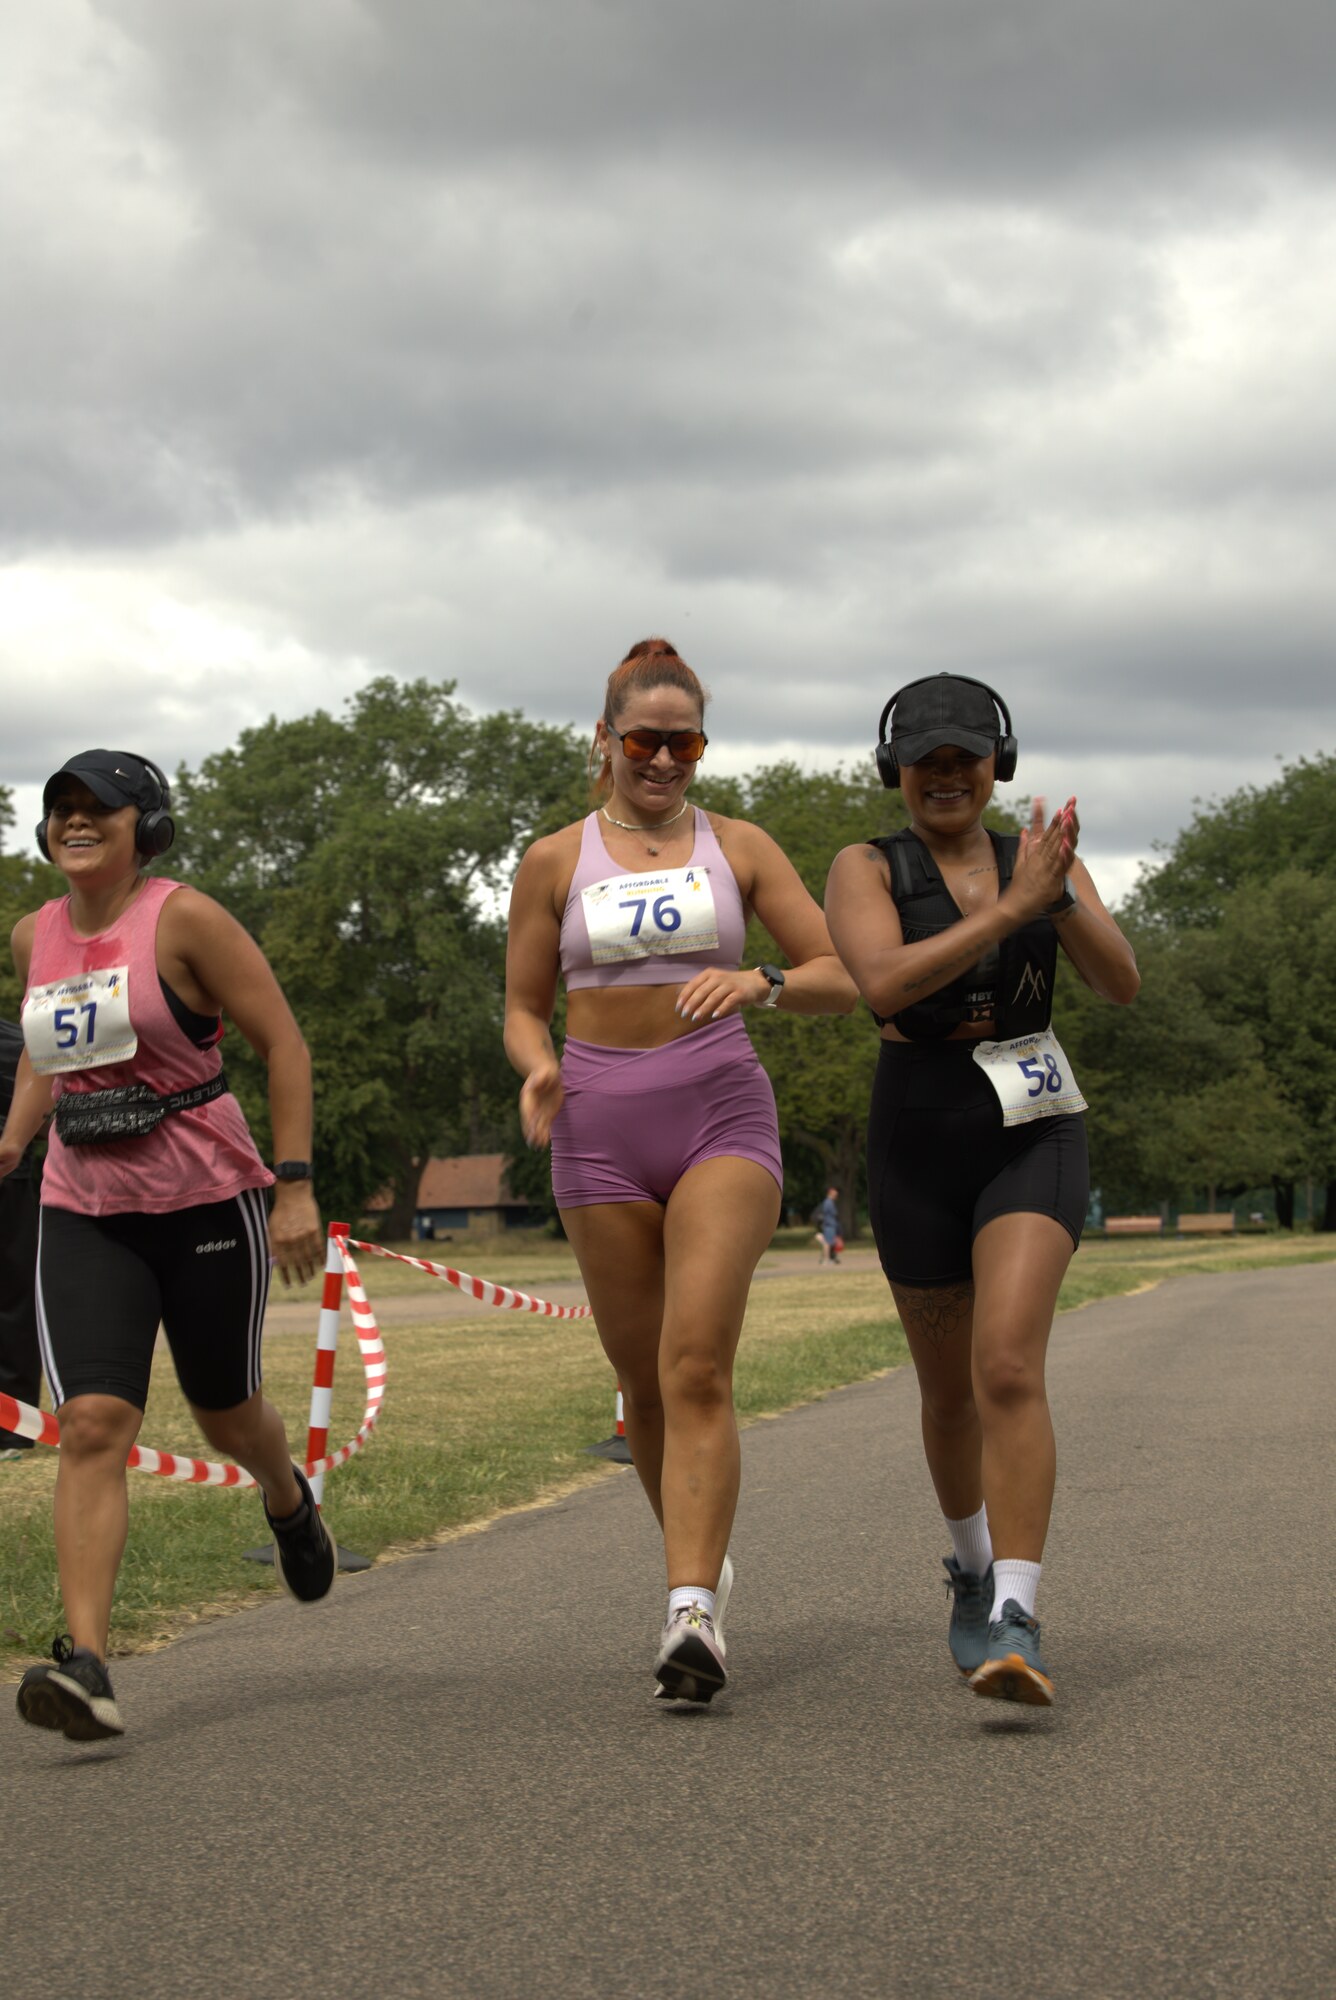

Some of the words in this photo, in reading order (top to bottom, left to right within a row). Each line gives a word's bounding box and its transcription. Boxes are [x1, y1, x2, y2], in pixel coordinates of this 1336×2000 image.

[618, 894, 682, 937] 76
[1016, 1053, 1062, 1098] 58
[195, 1238, 237, 1255] adidas
